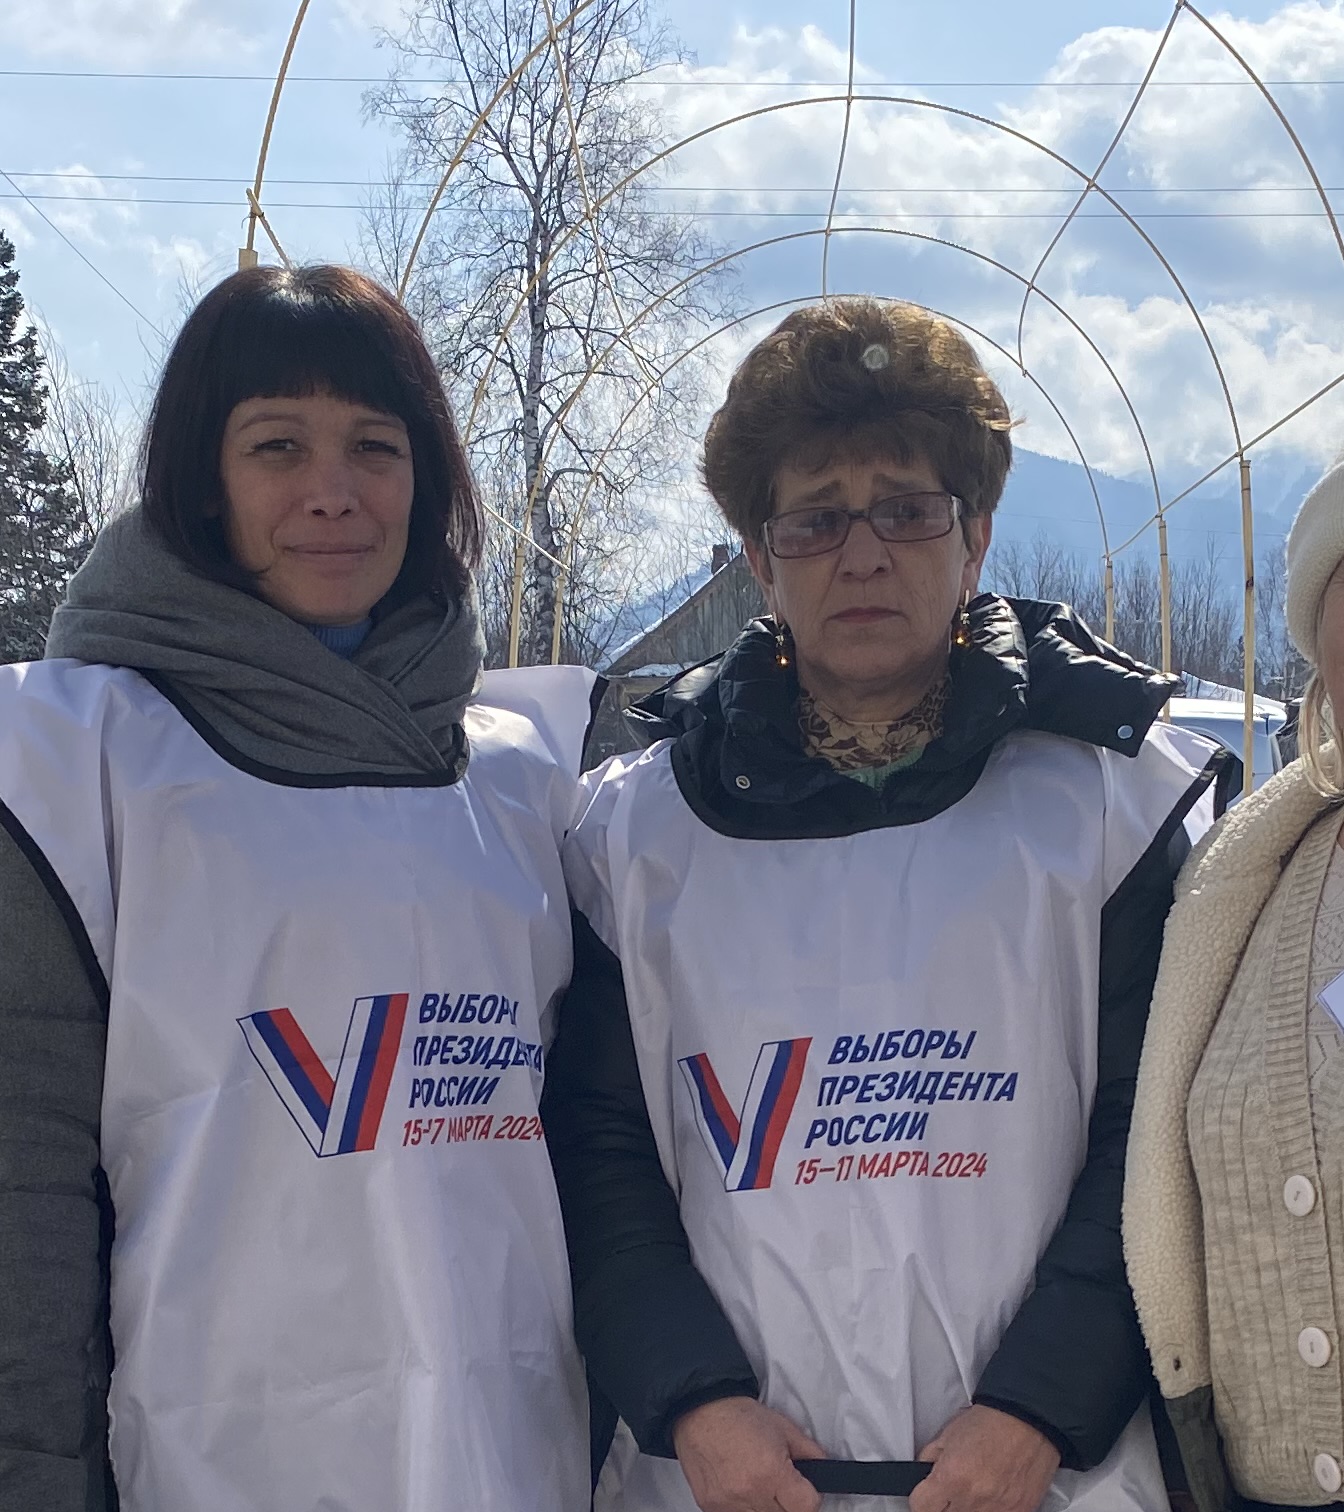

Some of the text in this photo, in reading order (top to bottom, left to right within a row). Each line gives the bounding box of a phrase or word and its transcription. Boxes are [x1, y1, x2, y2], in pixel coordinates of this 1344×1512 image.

[827, 1029, 978, 1065] ВЫБОРЫ
[409, 1076, 501, 1108] РОССИИ
[817, 1070, 1019, 1107] ПРЕЗИДЕНТА
[446, 1114, 495, 1143] МАРТА
[494, 1115, 544, 1141] 2024
[804, 1111, 930, 1149] РОССИИ
[856, 1150, 930, 1180] МАРТА
[931, 1152, 988, 1179] 2024
